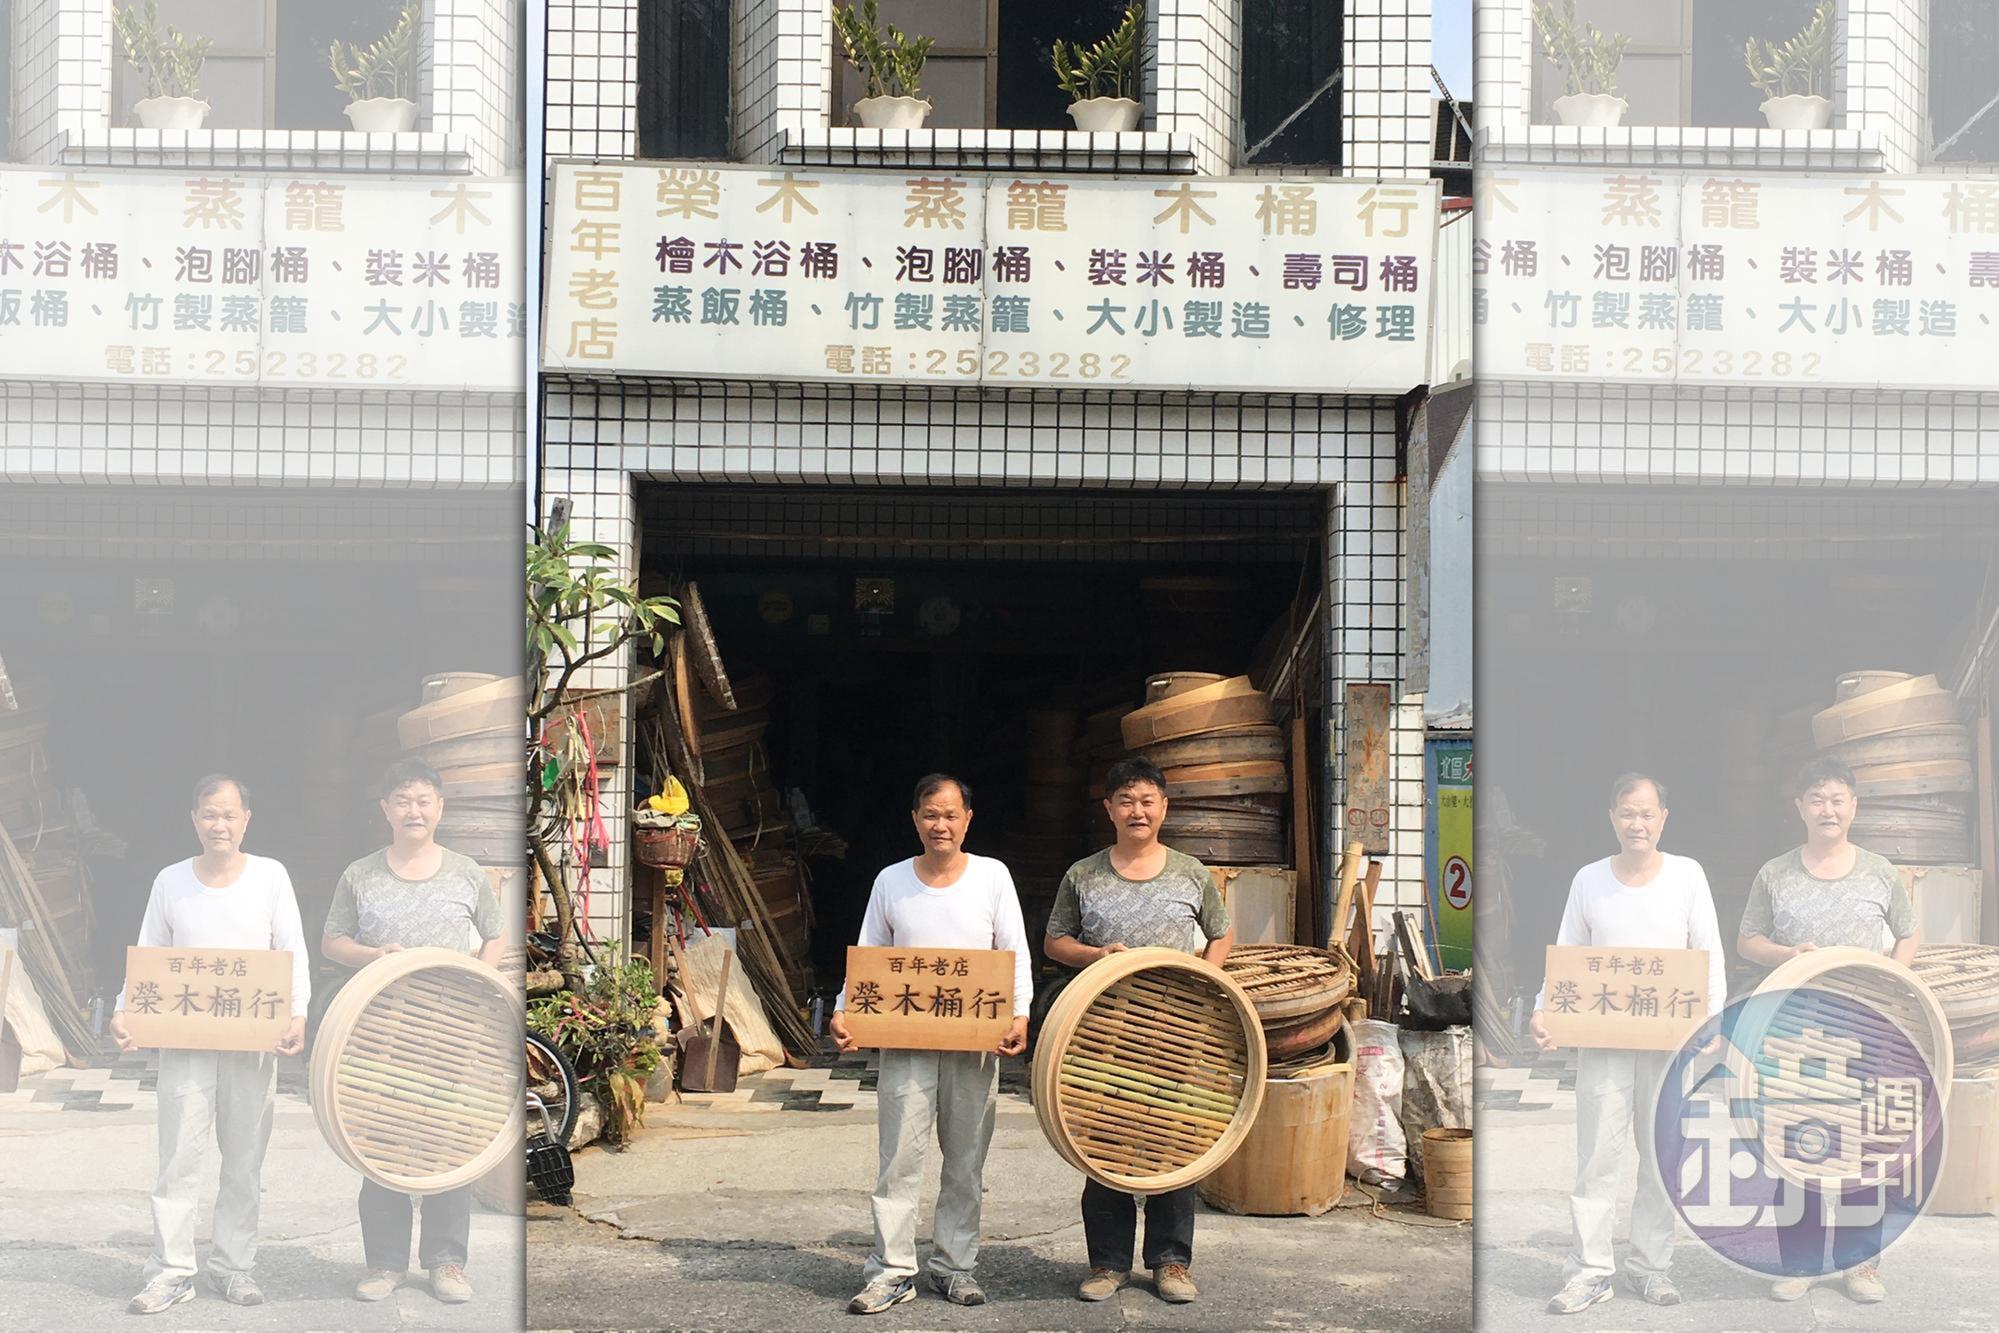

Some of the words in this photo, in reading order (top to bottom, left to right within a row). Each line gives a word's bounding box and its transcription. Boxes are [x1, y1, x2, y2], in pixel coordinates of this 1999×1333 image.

[566, 171, 624, 360] 百年老店
[1449, 863, 1467, 898] 2
[168, 956, 247, 977] 百年老店
[888, 956, 970, 977] 百年老店
[1586, 955, 1665, 976] 百年老店
[131, 981, 285, 1020] 榮木桶行
[851, 981, 1007, 1020] 榮木桶行
[1550, 980, 1701, 1019] 榮木桶行
